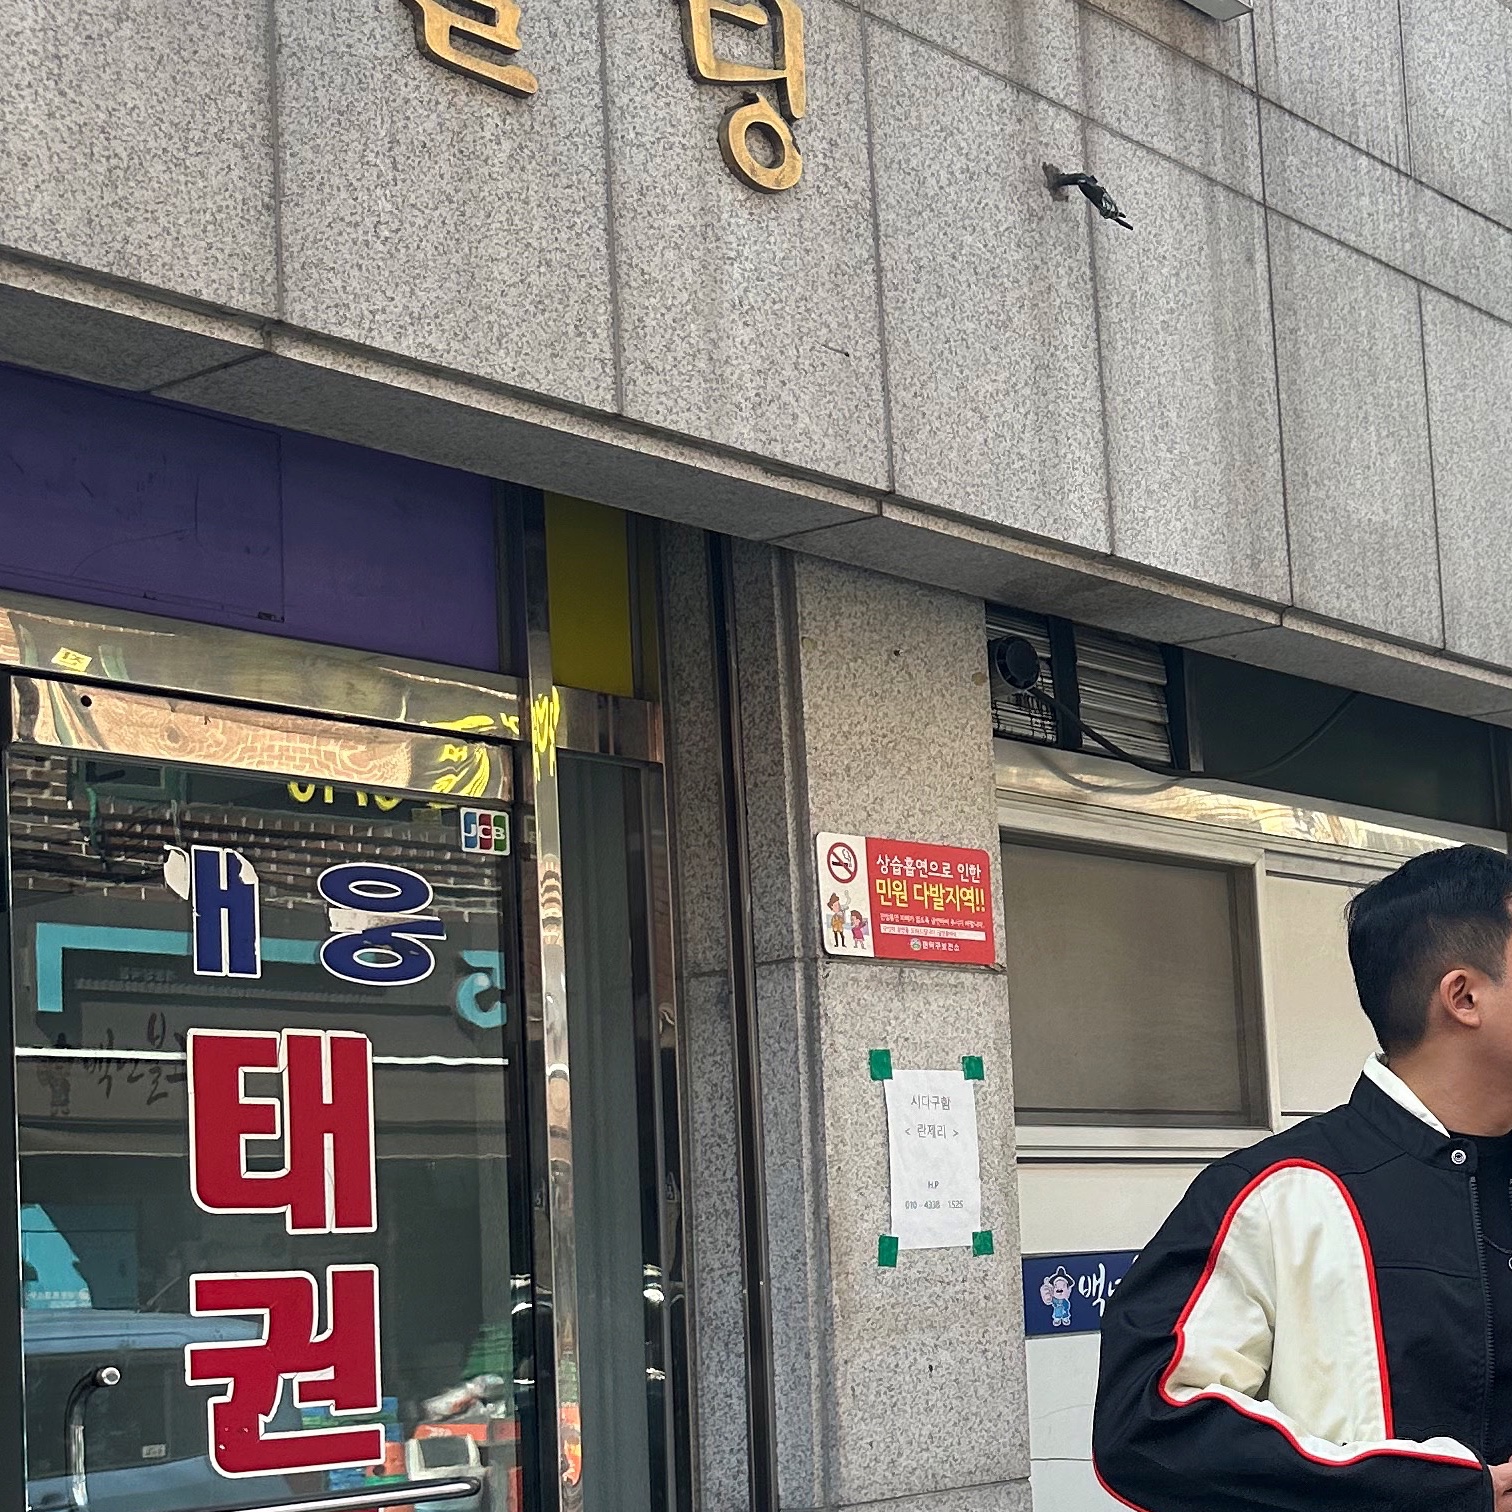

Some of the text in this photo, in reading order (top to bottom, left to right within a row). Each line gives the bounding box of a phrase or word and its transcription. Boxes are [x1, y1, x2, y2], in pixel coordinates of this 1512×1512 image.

[876, 853, 982, 884] 상습흡연으로 인한
[875, 878, 986, 914] 민원 다발지역!!
[911, 1095, 951, 1111] 시다구함
[917, 1123, 947, 1139] 란제리
